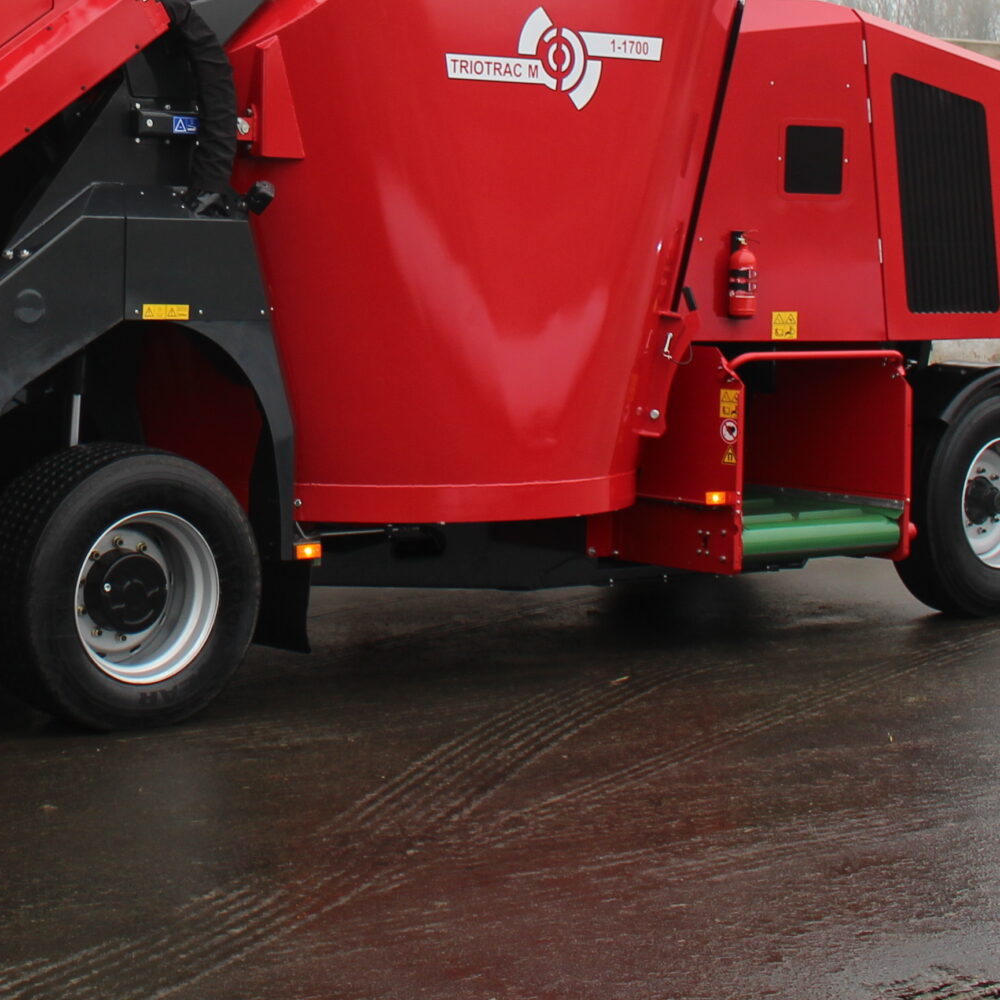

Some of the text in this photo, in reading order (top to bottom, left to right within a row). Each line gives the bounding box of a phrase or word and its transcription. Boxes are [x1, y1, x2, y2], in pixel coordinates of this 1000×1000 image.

[610, 40, 649, 56] 1-1700
[450, 58, 539, 79] TRIOTRAC M
